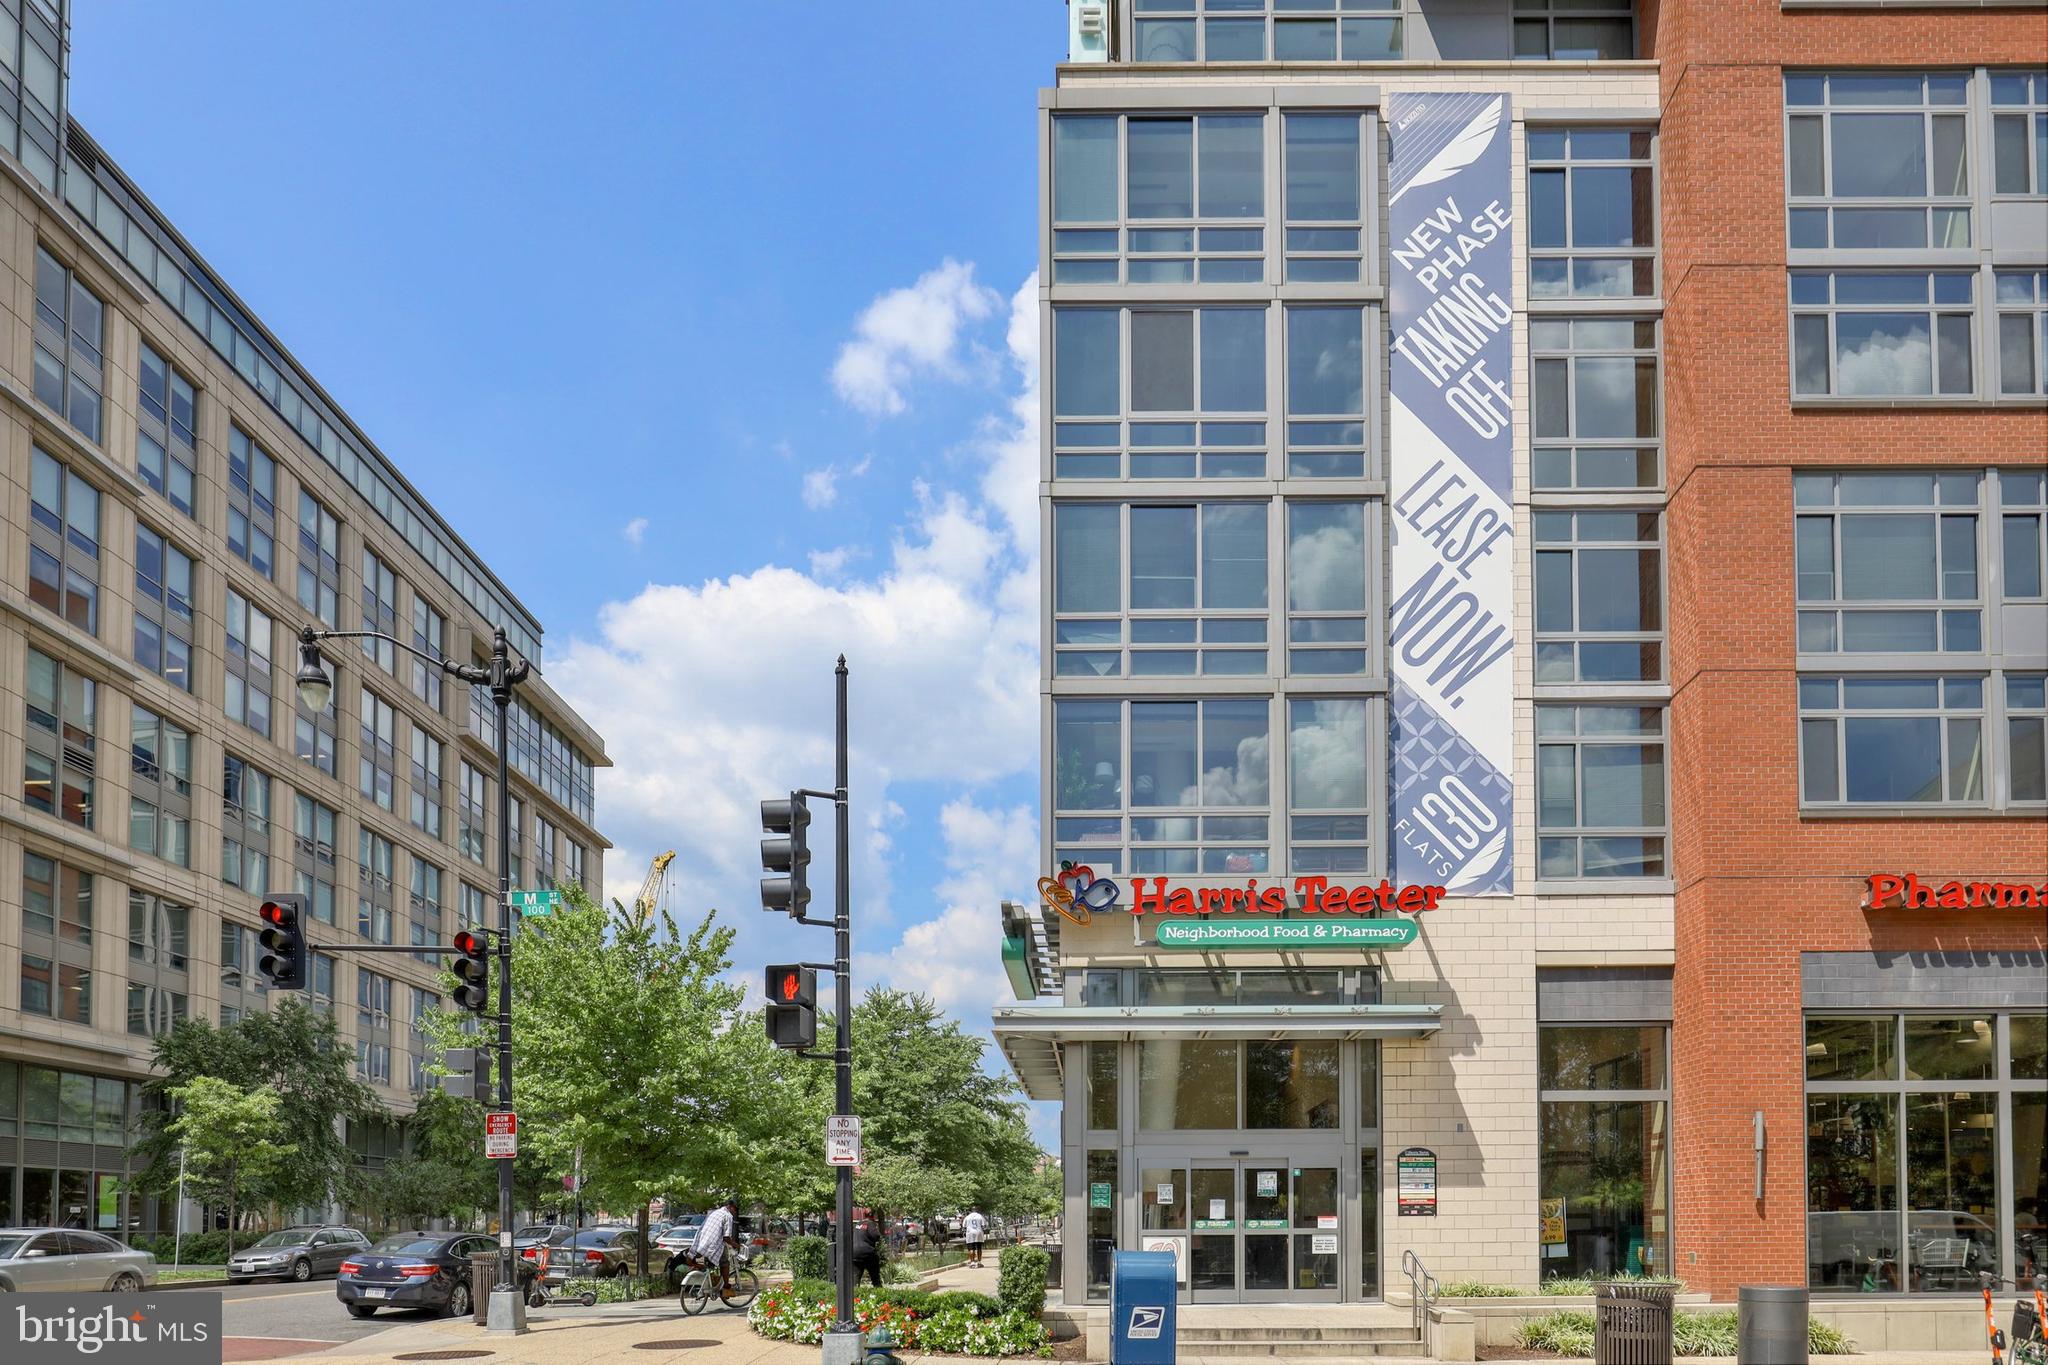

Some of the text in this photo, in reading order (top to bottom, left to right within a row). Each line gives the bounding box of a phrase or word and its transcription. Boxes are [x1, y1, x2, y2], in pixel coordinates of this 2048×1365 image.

[1391, 195, 1463, 271] NEW
[1415, 199, 1512, 295] PHASE
[1390, 272, 1512, 388] TAKING
[1444, 358, 1512, 440] OFF
[1392, 459, 1514, 580] LEASE
[1388, 561, 1514, 710] NOW.
[1393, 818, 1453, 877] FLATS
[1411, 774, 1498, 861] 130
[524, 892, 537, 905] M
[527, 905, 545, 914] 100
[1129, 875, 1447, 915] Harris Teeter
[1165, 925, 1409, 942] Neighborhood Food & Pharmacy
[829, 1129, 857, 1137] STOPPING
[837, 1119, 849, 1127] NO
